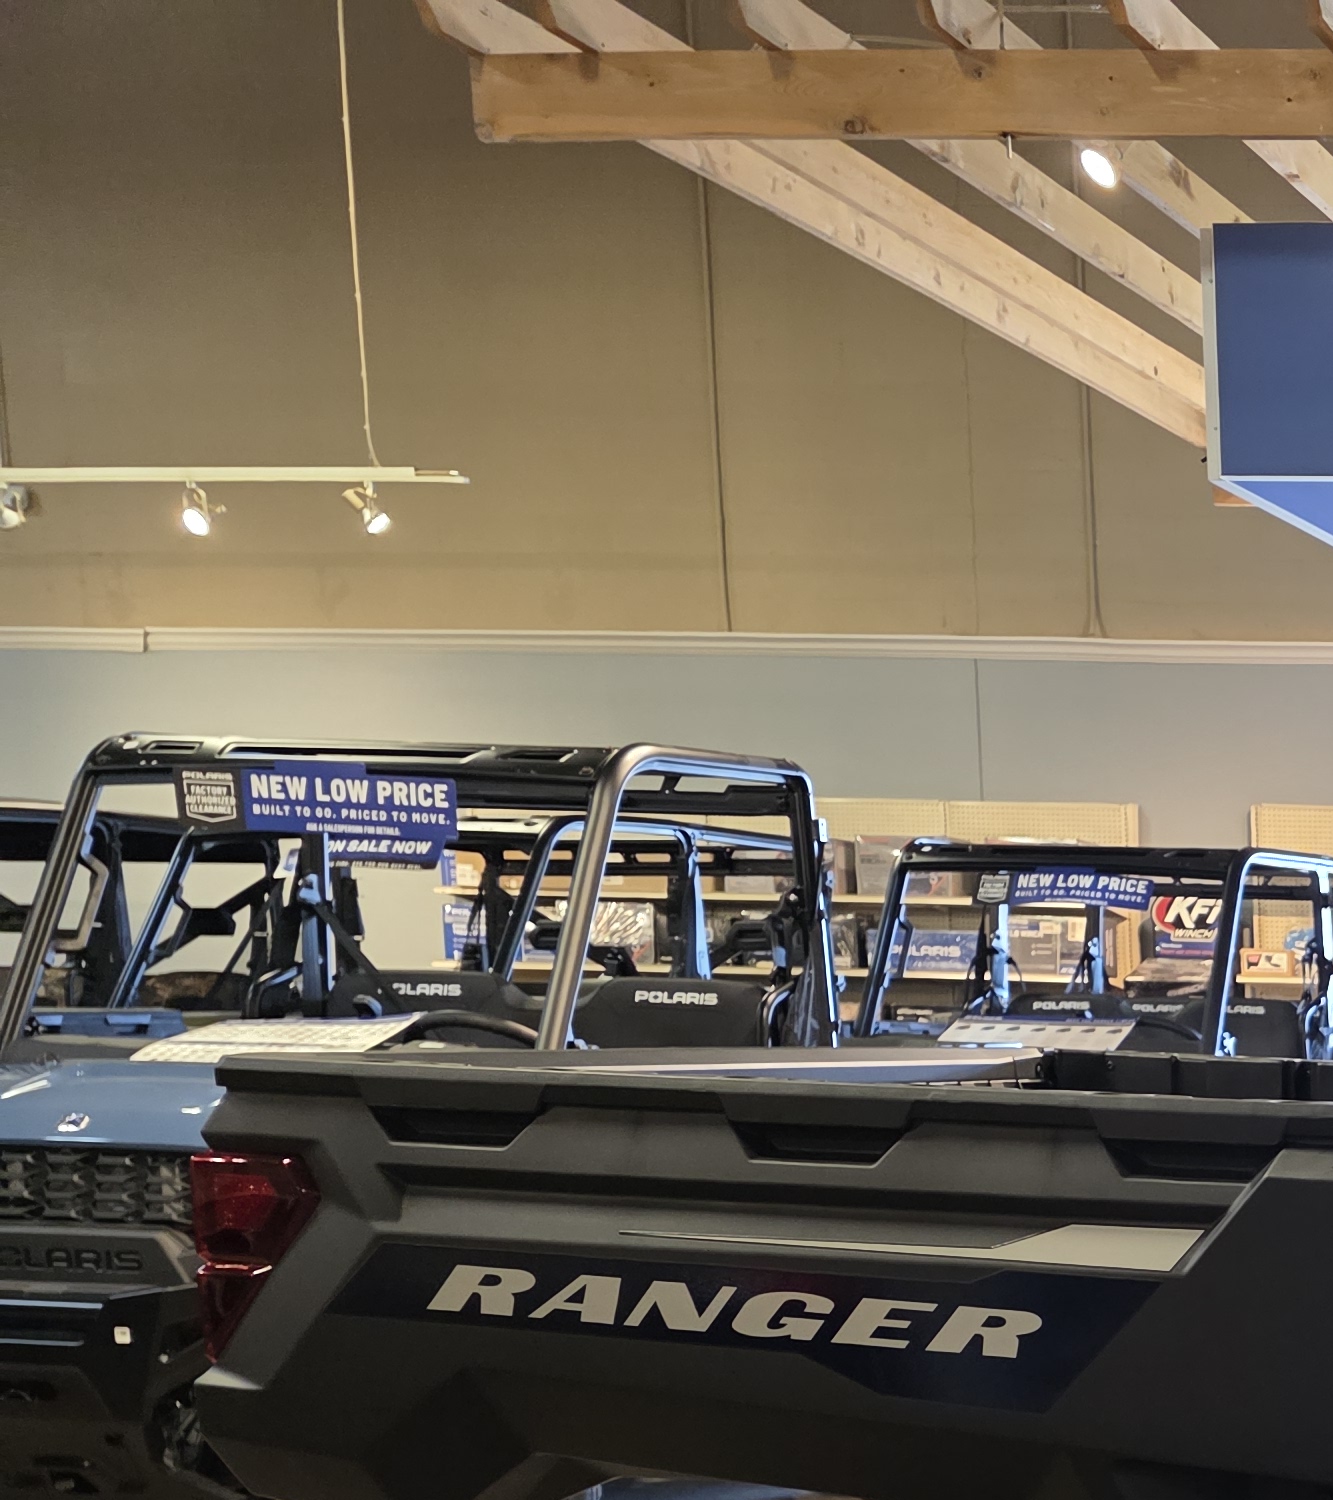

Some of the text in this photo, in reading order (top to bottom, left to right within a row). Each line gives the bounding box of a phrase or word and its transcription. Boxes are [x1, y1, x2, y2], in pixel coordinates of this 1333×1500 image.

[250, 774, 450, 808] NEW LOW PRICE
[252, 803, 290, 816] BUILT
[295, 805, 311, 817] TO
[341, 808, 387, 821] PRICED
[391, 811, 407, 822] TO
[346, 840, 391, 853] SALE
[392, 840, 432, 854] NOW
[1017, 873, 1054, 888] NEW
[1056, 874, 1095, 890] LOW
[1097, 876, 1149, 894] PRICE
[892, 944, 962, 957] PLARIS
[392, 983, 462, 996] OLARIS
[635, 990, 718, 1006] POLARIS
[1032, 1001, 1090, 1011] POLARIS
[1227, 1006, 1265, 1014] LARIS
[0, 1247, 143, 1271] OLARIS
[426, 1264, 1042, 1358] RANGER
